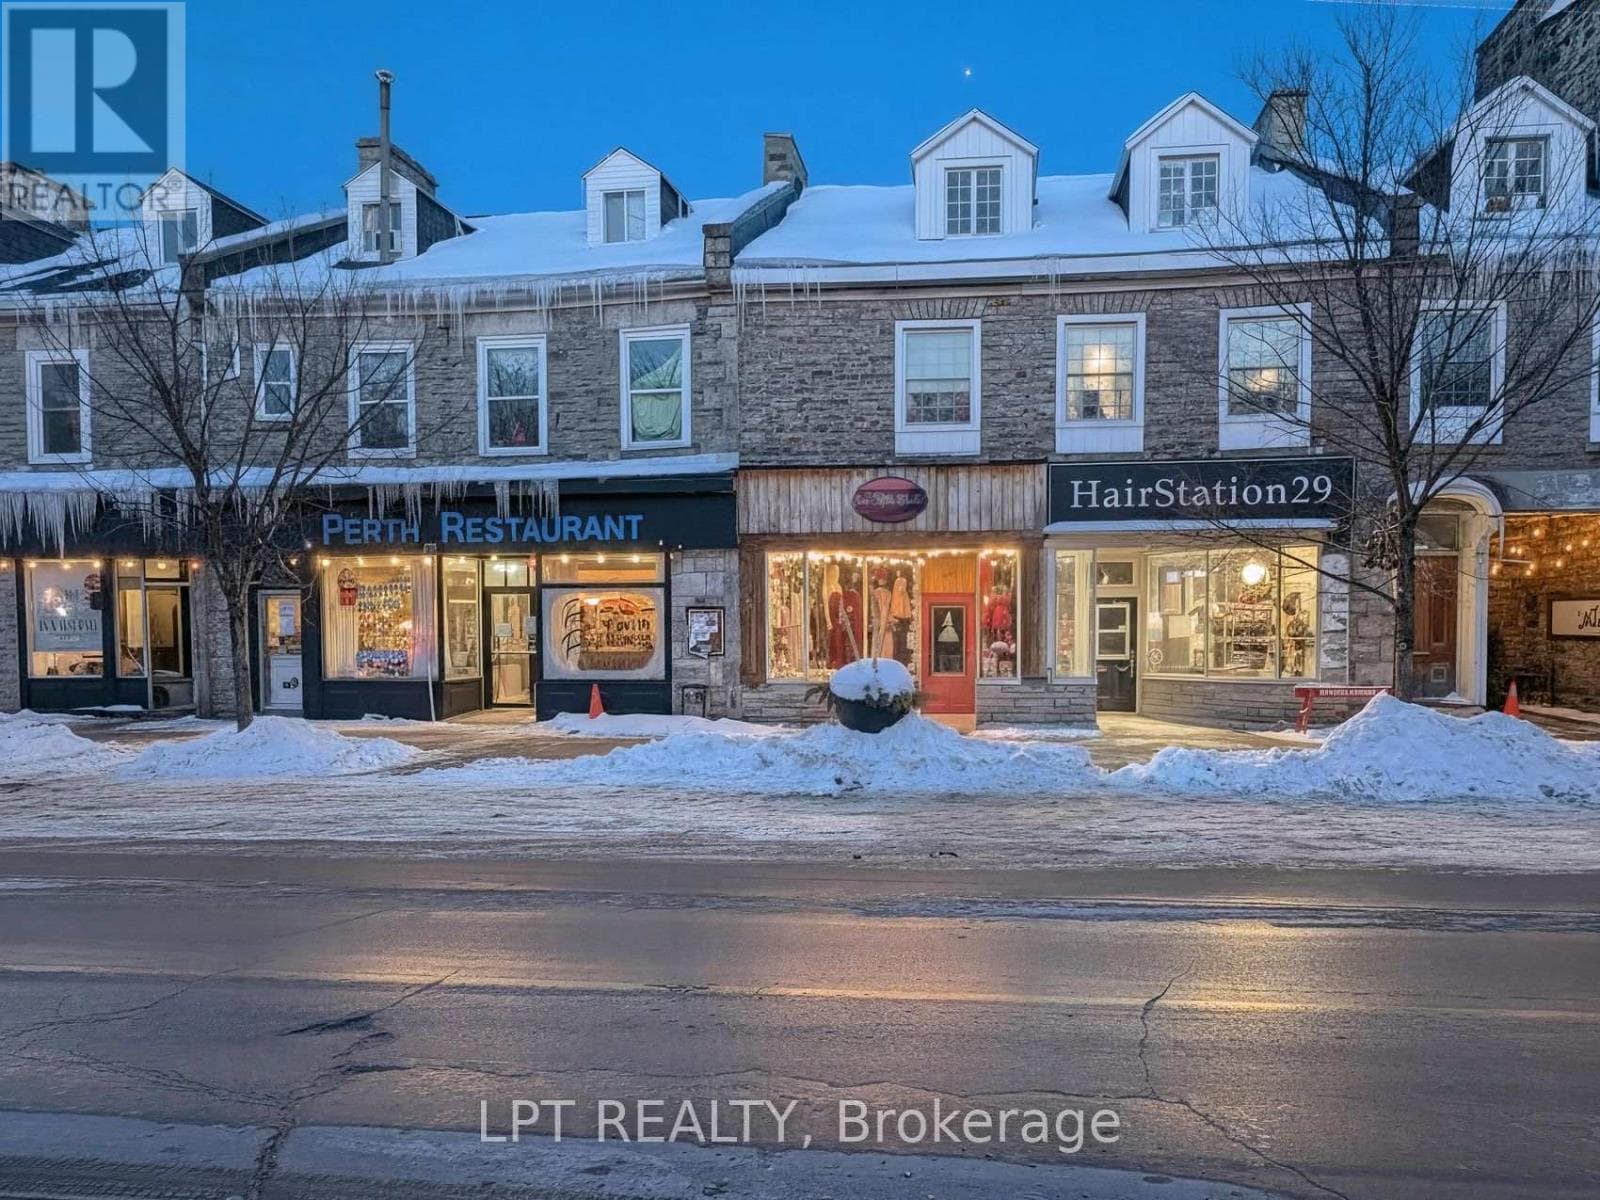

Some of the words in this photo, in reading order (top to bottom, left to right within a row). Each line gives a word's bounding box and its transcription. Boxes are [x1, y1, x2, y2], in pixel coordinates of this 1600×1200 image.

[1070, 475, 1332, 508] HairStation29
[322, 513, 420, 545] PERTH
[441, 511, 644, 543] RESTAURANT
